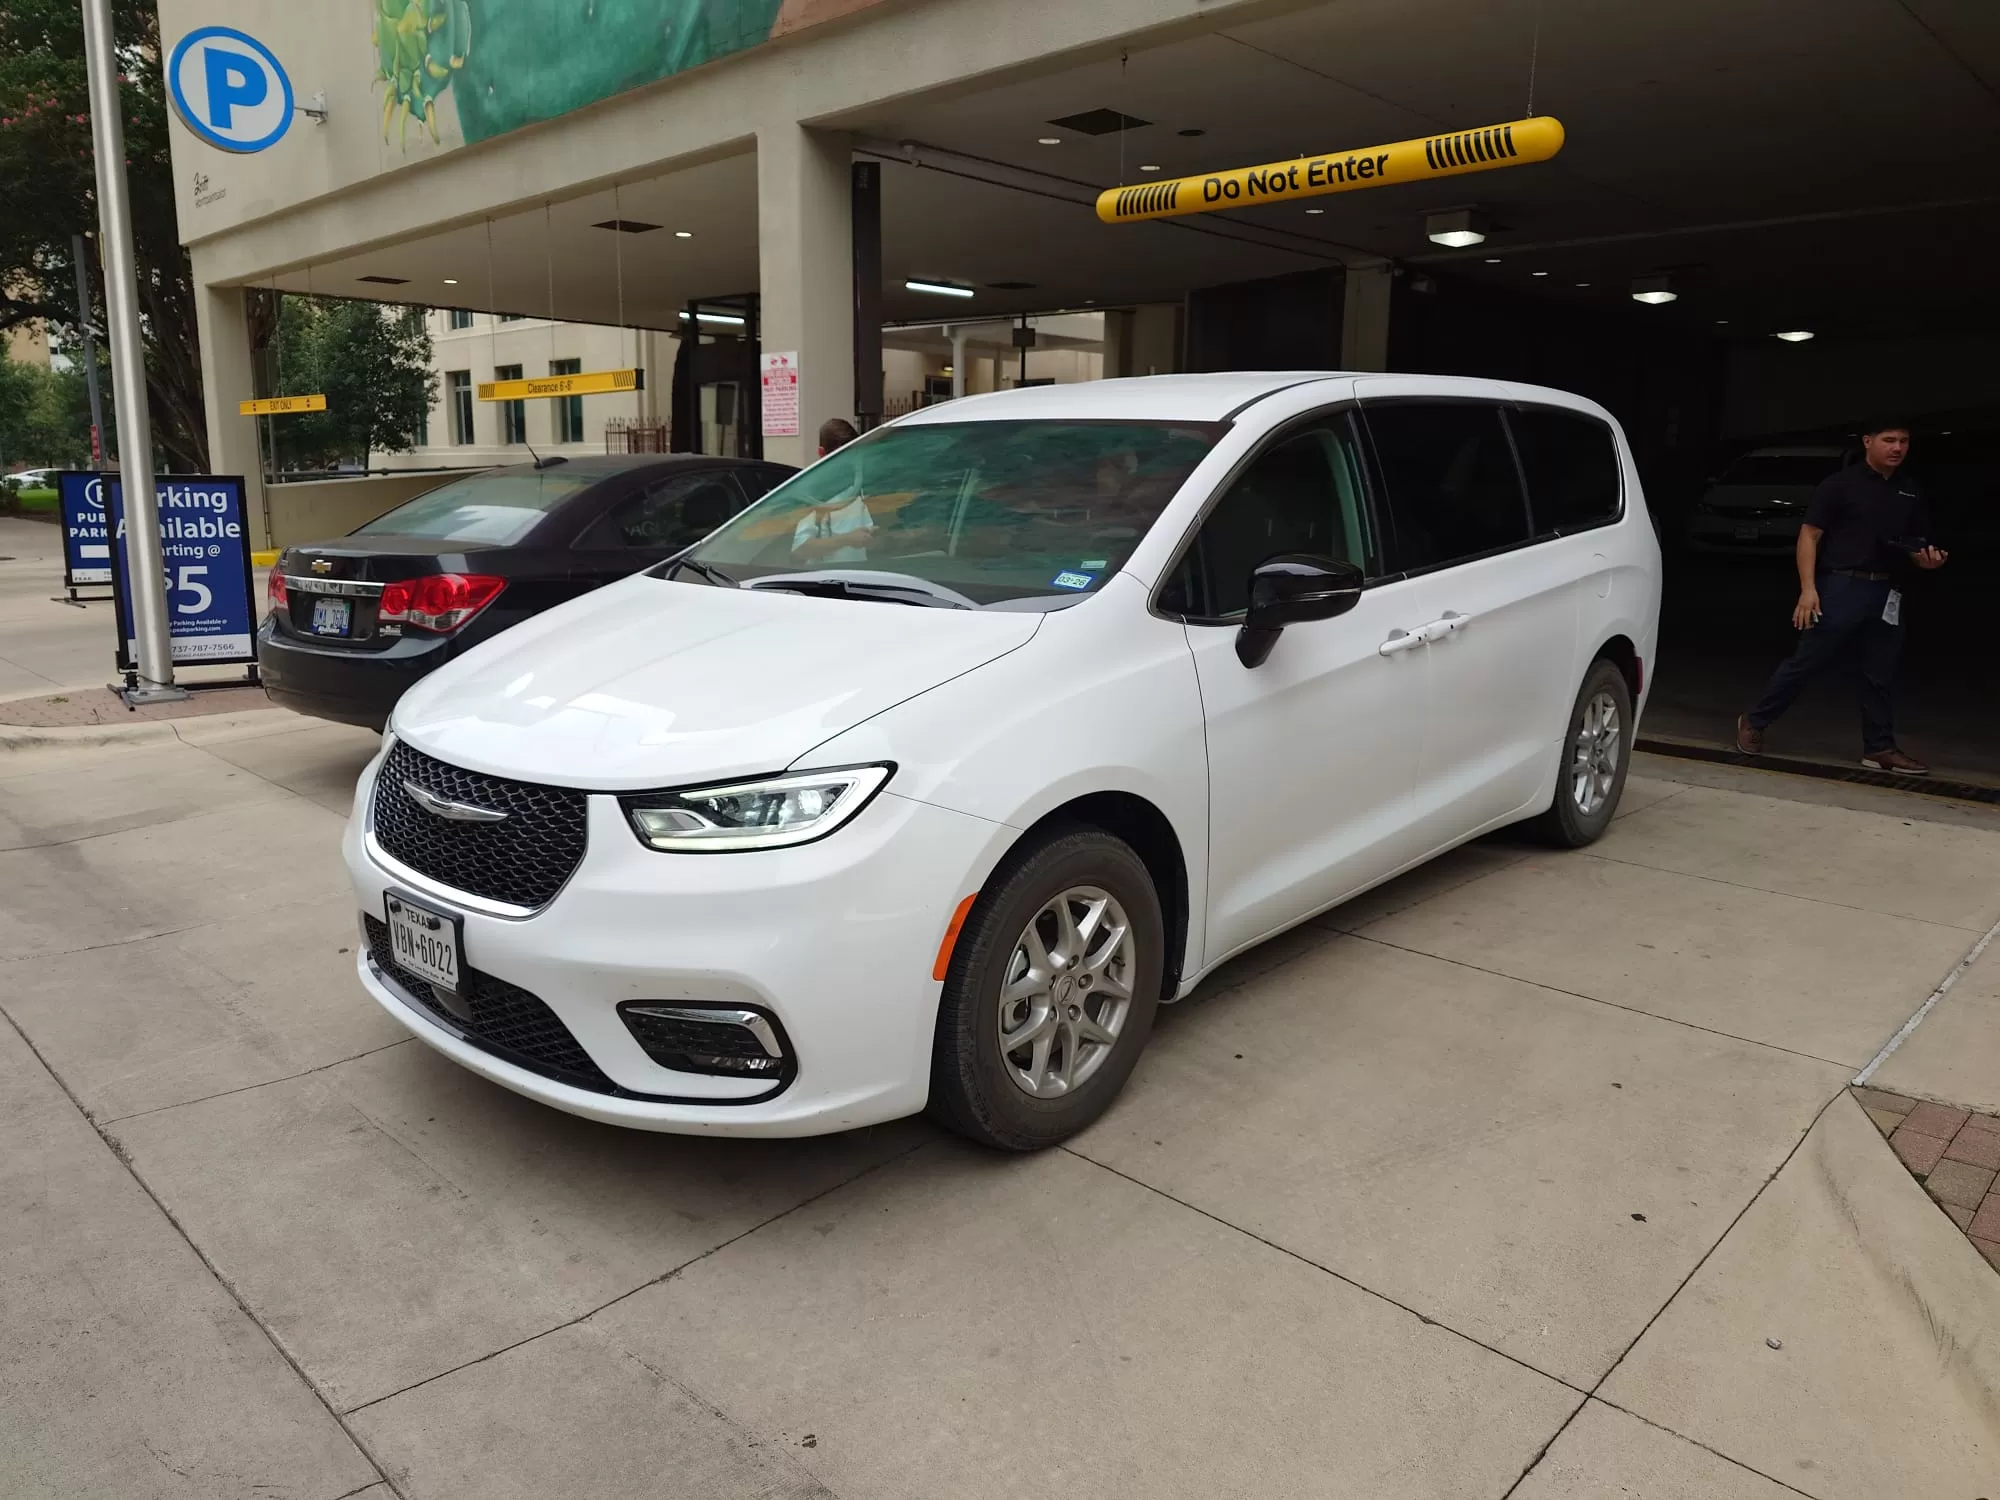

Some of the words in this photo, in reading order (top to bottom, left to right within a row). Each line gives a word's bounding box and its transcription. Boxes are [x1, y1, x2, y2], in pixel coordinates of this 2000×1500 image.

[203, 46, 267, 130] P
[1203, 176, 1240, 203] Do
[1247, 165, 1299, 197] Not
[1307, 151, 1389, 188] Enter
[527, 381, 558, 394] Clearance
[269, 400, 280, 411] EXIT
[280, 399, 292, 410] ONLY
[156, 486, 228, 513] rking
[77, 512, 106, 523] PUB
[69, 527, 108, 538] PARK
[115, 516, 241, 539] Aailable
[163, 544, 204, 559] rting
[207, 544, 221, 557] @
[173, 619, 195, 627] Parking
[171, 643, 235, 653] 737-787-7566
